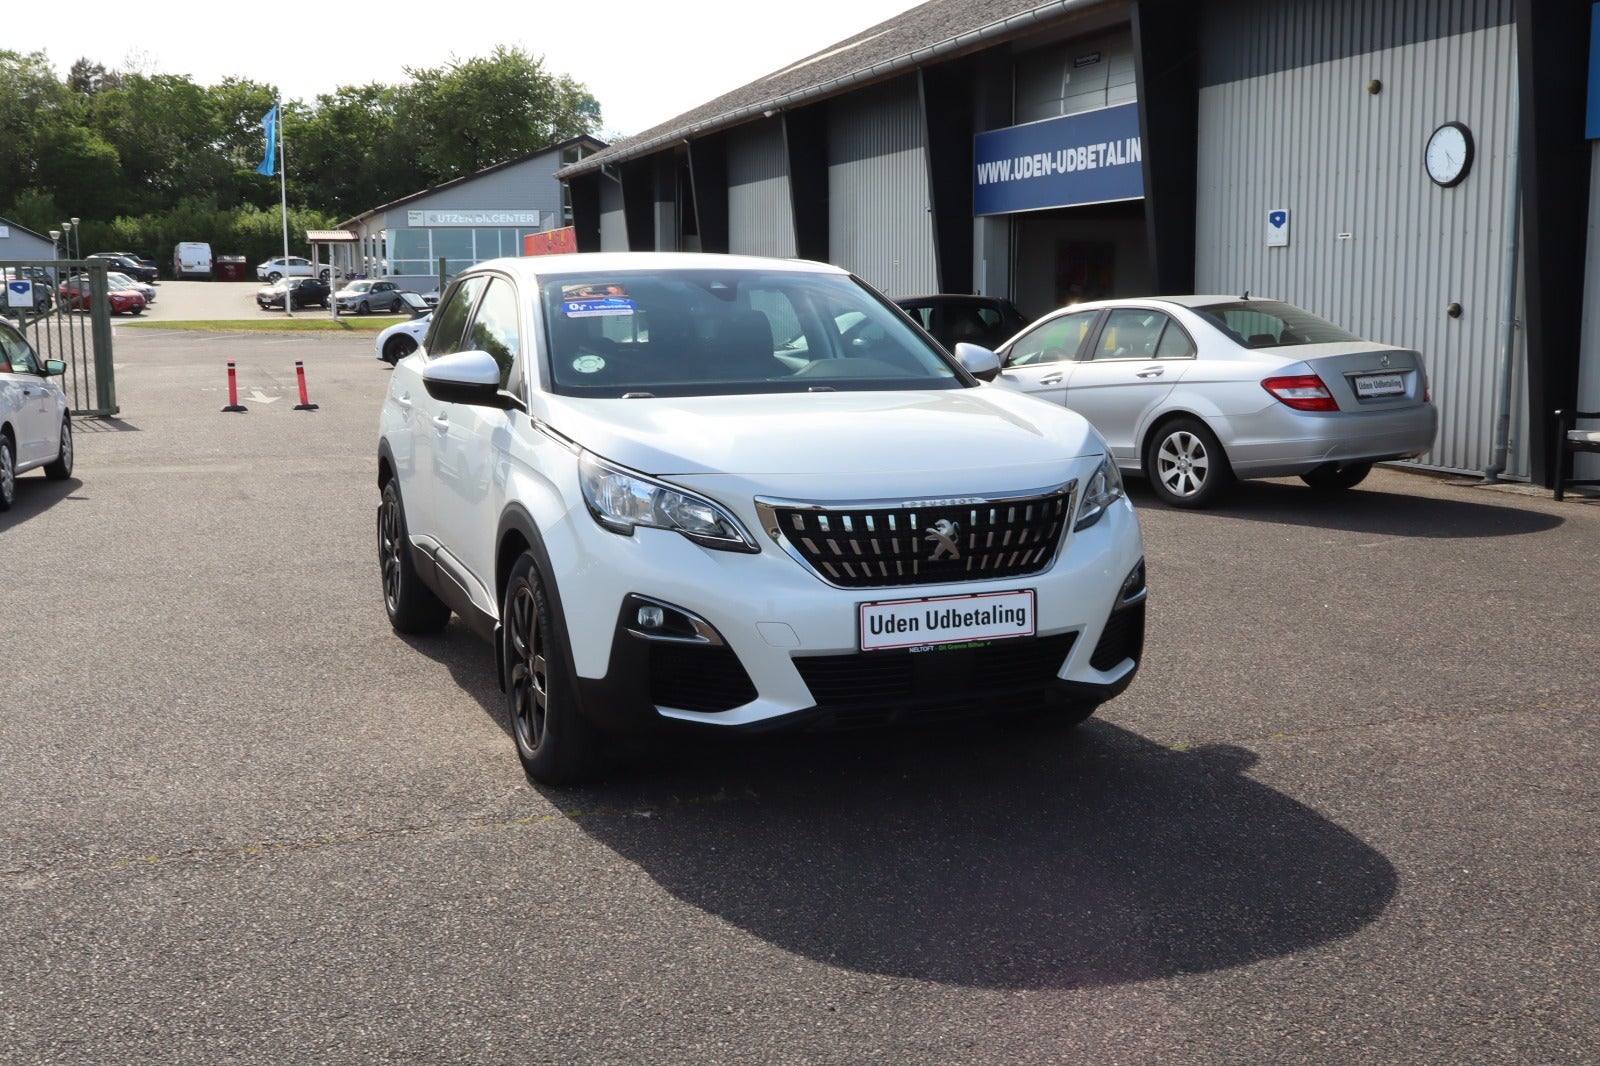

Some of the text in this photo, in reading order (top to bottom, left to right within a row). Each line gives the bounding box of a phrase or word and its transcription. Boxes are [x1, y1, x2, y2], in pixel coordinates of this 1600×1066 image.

[1359, 380, 1373, 390] Uden
[910, 499, 975, 507] PEUGEOT
[870, 605, 1026, 635] Uden Udbetaling
[909, 645, 934, 653] NELTOFT
